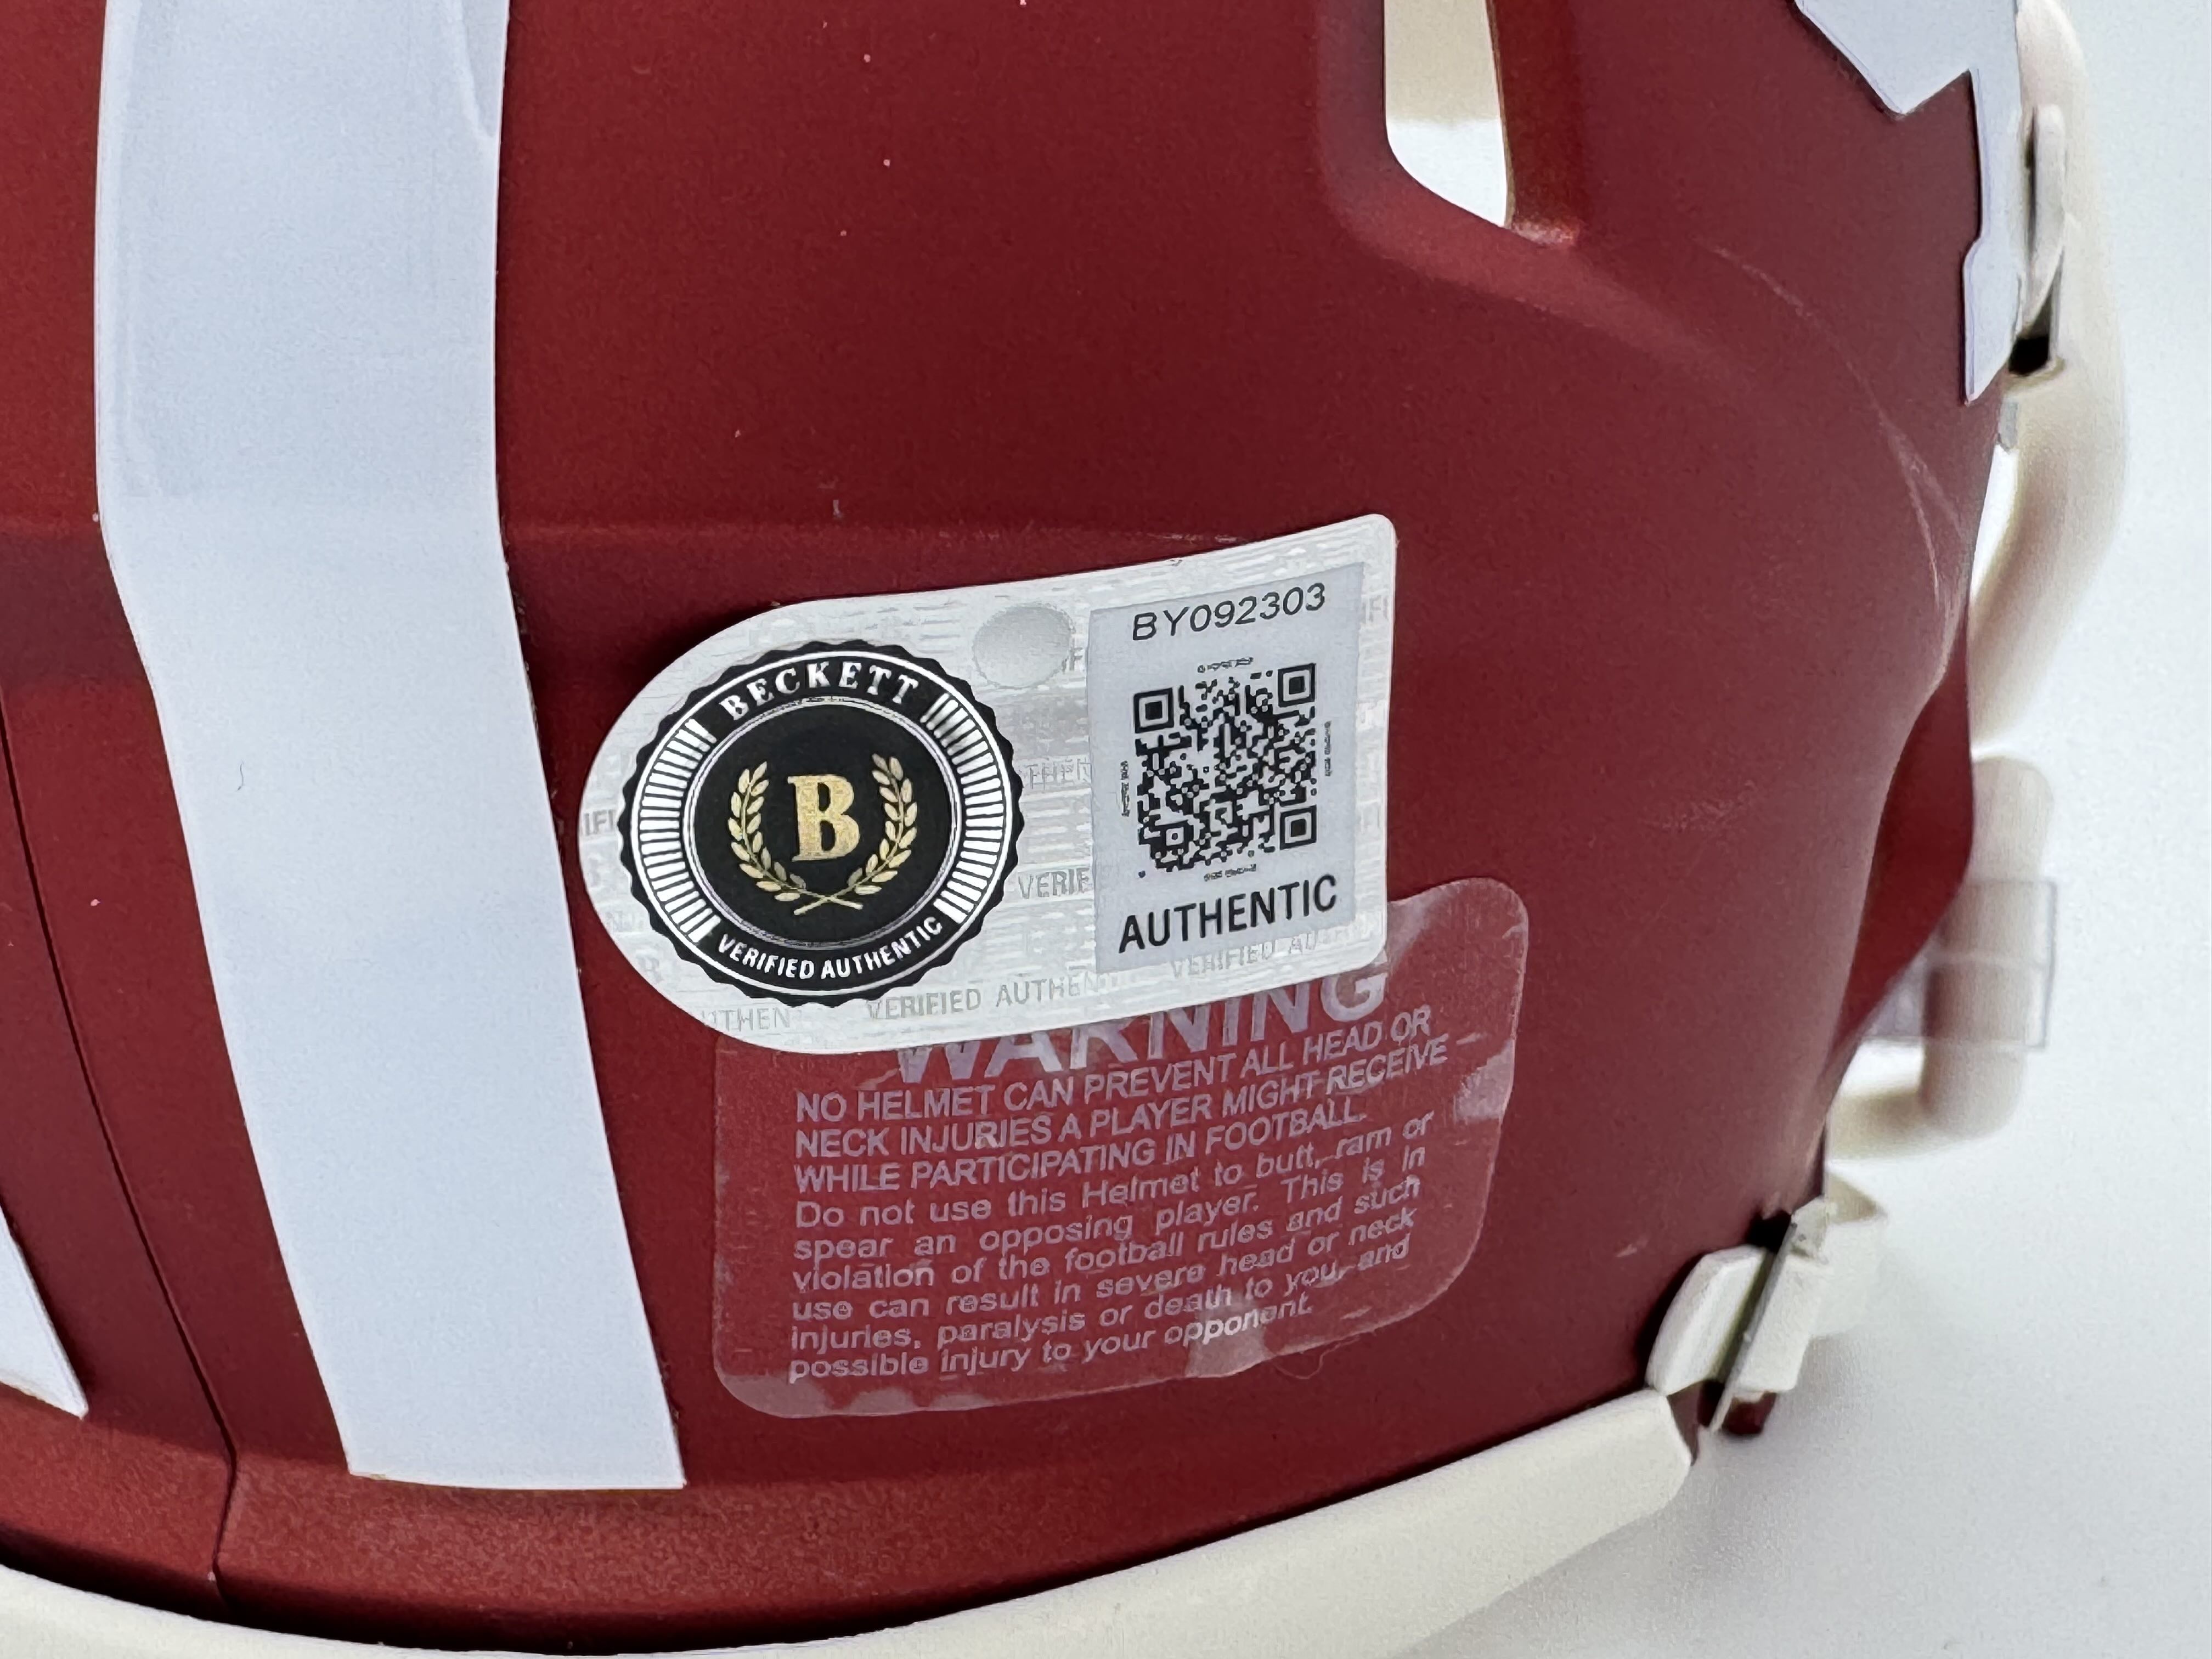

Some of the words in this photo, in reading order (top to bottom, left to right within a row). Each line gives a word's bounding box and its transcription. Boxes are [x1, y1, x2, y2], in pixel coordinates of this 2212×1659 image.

[1132, 582, 1325, 640] BY092303
[719, 662, 918, 720] BECKETT
[788, 774, 860, 862] B
[718, 933, 815, 979] VERIFIED
[821, 916, 943, 979] AUTHENTIC
[1119, 874, 1336, 953] AUTHENTIC
[866, 989, 981, 1022] VERIFIED
[795, 1127, 889, 1158] NECK
[901, 1116, 1052, 1154] INJURIES
[1059, 1113, 1082, 1141] A
[1090, 1094, 1211, 1138] PLAYER
[1222, 1072, 1317, 1116] MIGHT
[1326, 1034, 1449, 1095] RECEIVE
[797, 1092, 847, 1122] NO
[857, 1085, 995, 1120] HELMET
[1005, 1077, 1074, 1110] CAN
[1084, 1054, 1236, 1099] PREVENT
[1242, 1043, 1293, 1079] ALL
[1303, 1020, 1383, 1064] HEAD
[1391, 1005, 1430, 1042] OR
[795, 1161, 900, 1194] WHILE
[912, 1137, 1156, 1189] PARTICIPATING
[1166, 1132, 1195, 1164] IN
[796, 1200, 843, 1228] Do
[860, 1199, 915, 1227] not
[930, 1200, 991, 1223] use
[1008, 1189, 1066, 1216] this
[1082, 1170, 1201, 1208] Helmet
[1216, 1161, 1243, 1187] to
[1336, 1124, 1392, 1159] ram
[1402, 1111, 1434, 1139] or
[793, 1262, 934, 1293] violation
[951, 1254, 985, 1283] of
[999, 1252, 1050, 1278] the
[1065, 1232, 1183, 1272] football
[1198, 1220, 1272, 1251] rules
[1287, 1200, 1342, 1232] and
[1355, 1175, 1420, 1216] such
[794, 1239, 893, 1269] spear
[915, 1233, 956, 1255] an
[980, 1214, 1133, 1255] opposing
[1156, 1192, 1259, 1234] player.
[1281, 1170, 1344, 1203] This
[1362, 1159, 1385, 1183] is
[792, 1299, 853, 1321] use
[869, 1296, 930, 1318] can
[946, 1285, 1039, 1314] result
[1055, 1279, 1080, 1303] in
[1096, 1269, 1205, 1297] severe
[1220, 1242, 1296, 1277] head
[1307, 1232, 1339, 1257] or
[1348, 1208, 1417, 1248] neck
[938, 1313, 1086, 1348] paralysis
[1099, 1306, 1132, 1328] or
[1145, 1286, 1232, 1321] death
[1245, 1278, 1272, 1300] to
[1357, 1232, 1409, 1269] and
[789, 1352, 929, 1384] possible
[940, 1347, 1031, 1375] injury
[1042, 1343, 1072, 1362] to
[1080, 1327, 1155, 1364] your
